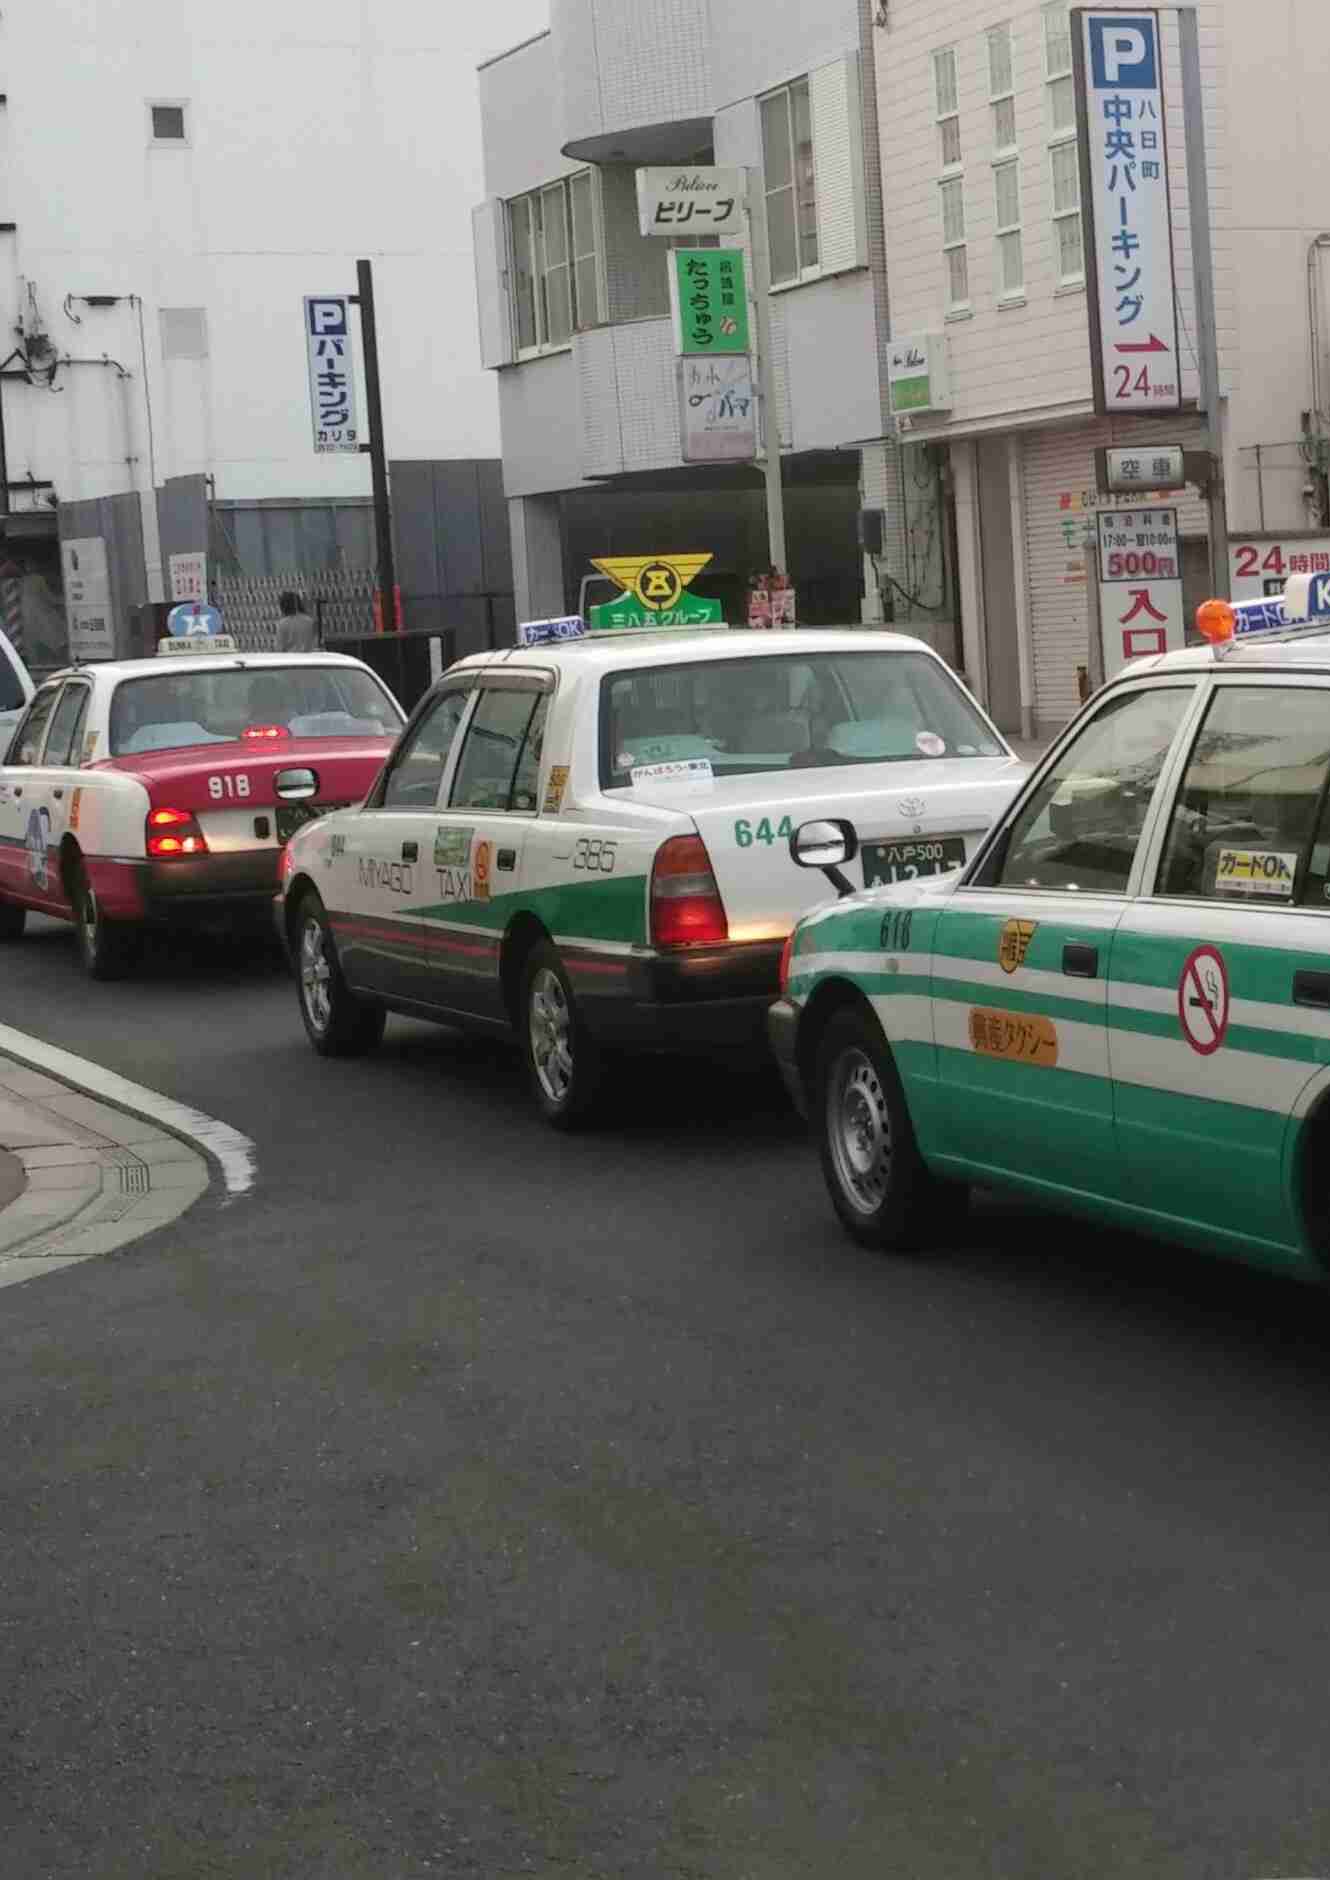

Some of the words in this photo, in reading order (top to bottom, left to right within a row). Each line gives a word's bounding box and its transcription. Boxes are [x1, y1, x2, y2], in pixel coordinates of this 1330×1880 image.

[1101, 27, 1146, 82] P
[1138, 99, 1161, 181] 八日町
[1103, 95, 1145, 327] 中央パーキング
[313, 303, 342, 334] P
[1120, 589, 1168, 658] 入口
[208, 774, 251, 799] 918
[734, 815, 793, 848] 644
[888, 843, 944, 864] 八戸500
[436, 868, 473, 904] TAXI
[880, 911, 912, 950] 618
